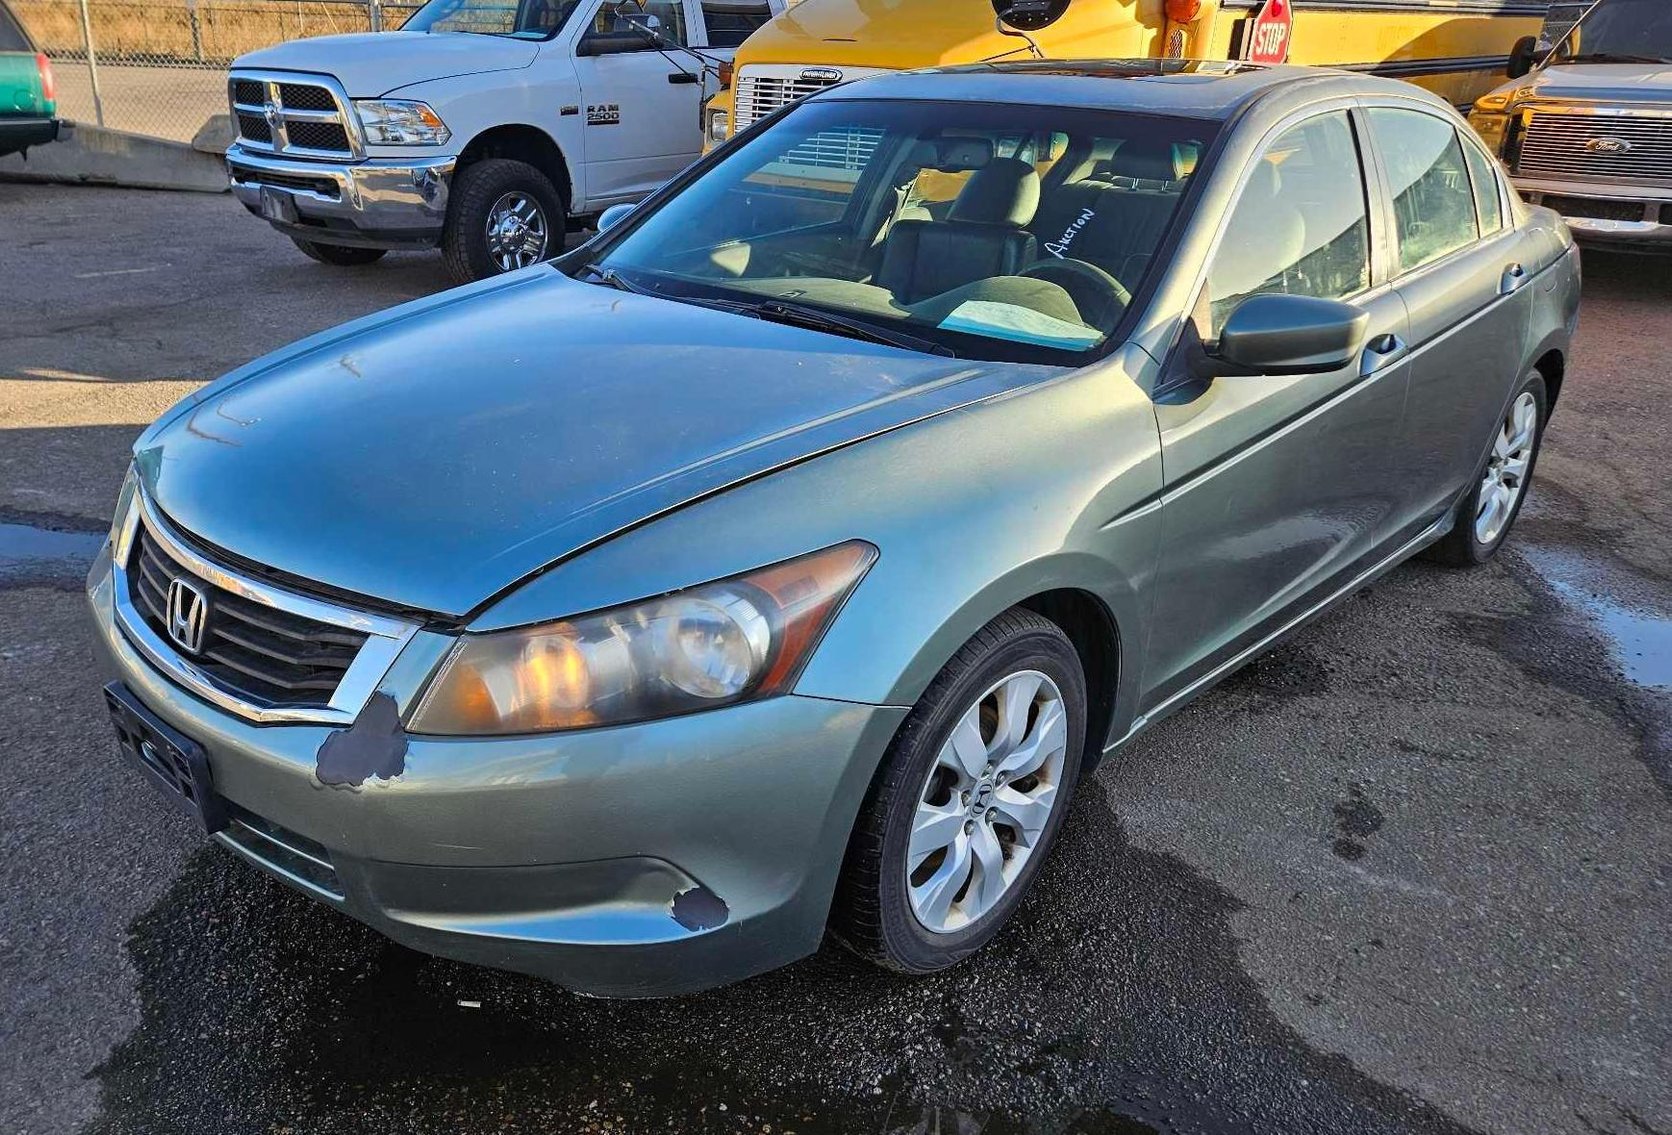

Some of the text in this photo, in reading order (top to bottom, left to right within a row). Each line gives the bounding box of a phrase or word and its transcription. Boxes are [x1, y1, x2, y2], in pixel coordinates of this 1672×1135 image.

[1256, 22, 1287, 55] STOP
[587, 104, 619, 112] RAM
[587, 112, 619, 120] 2500
